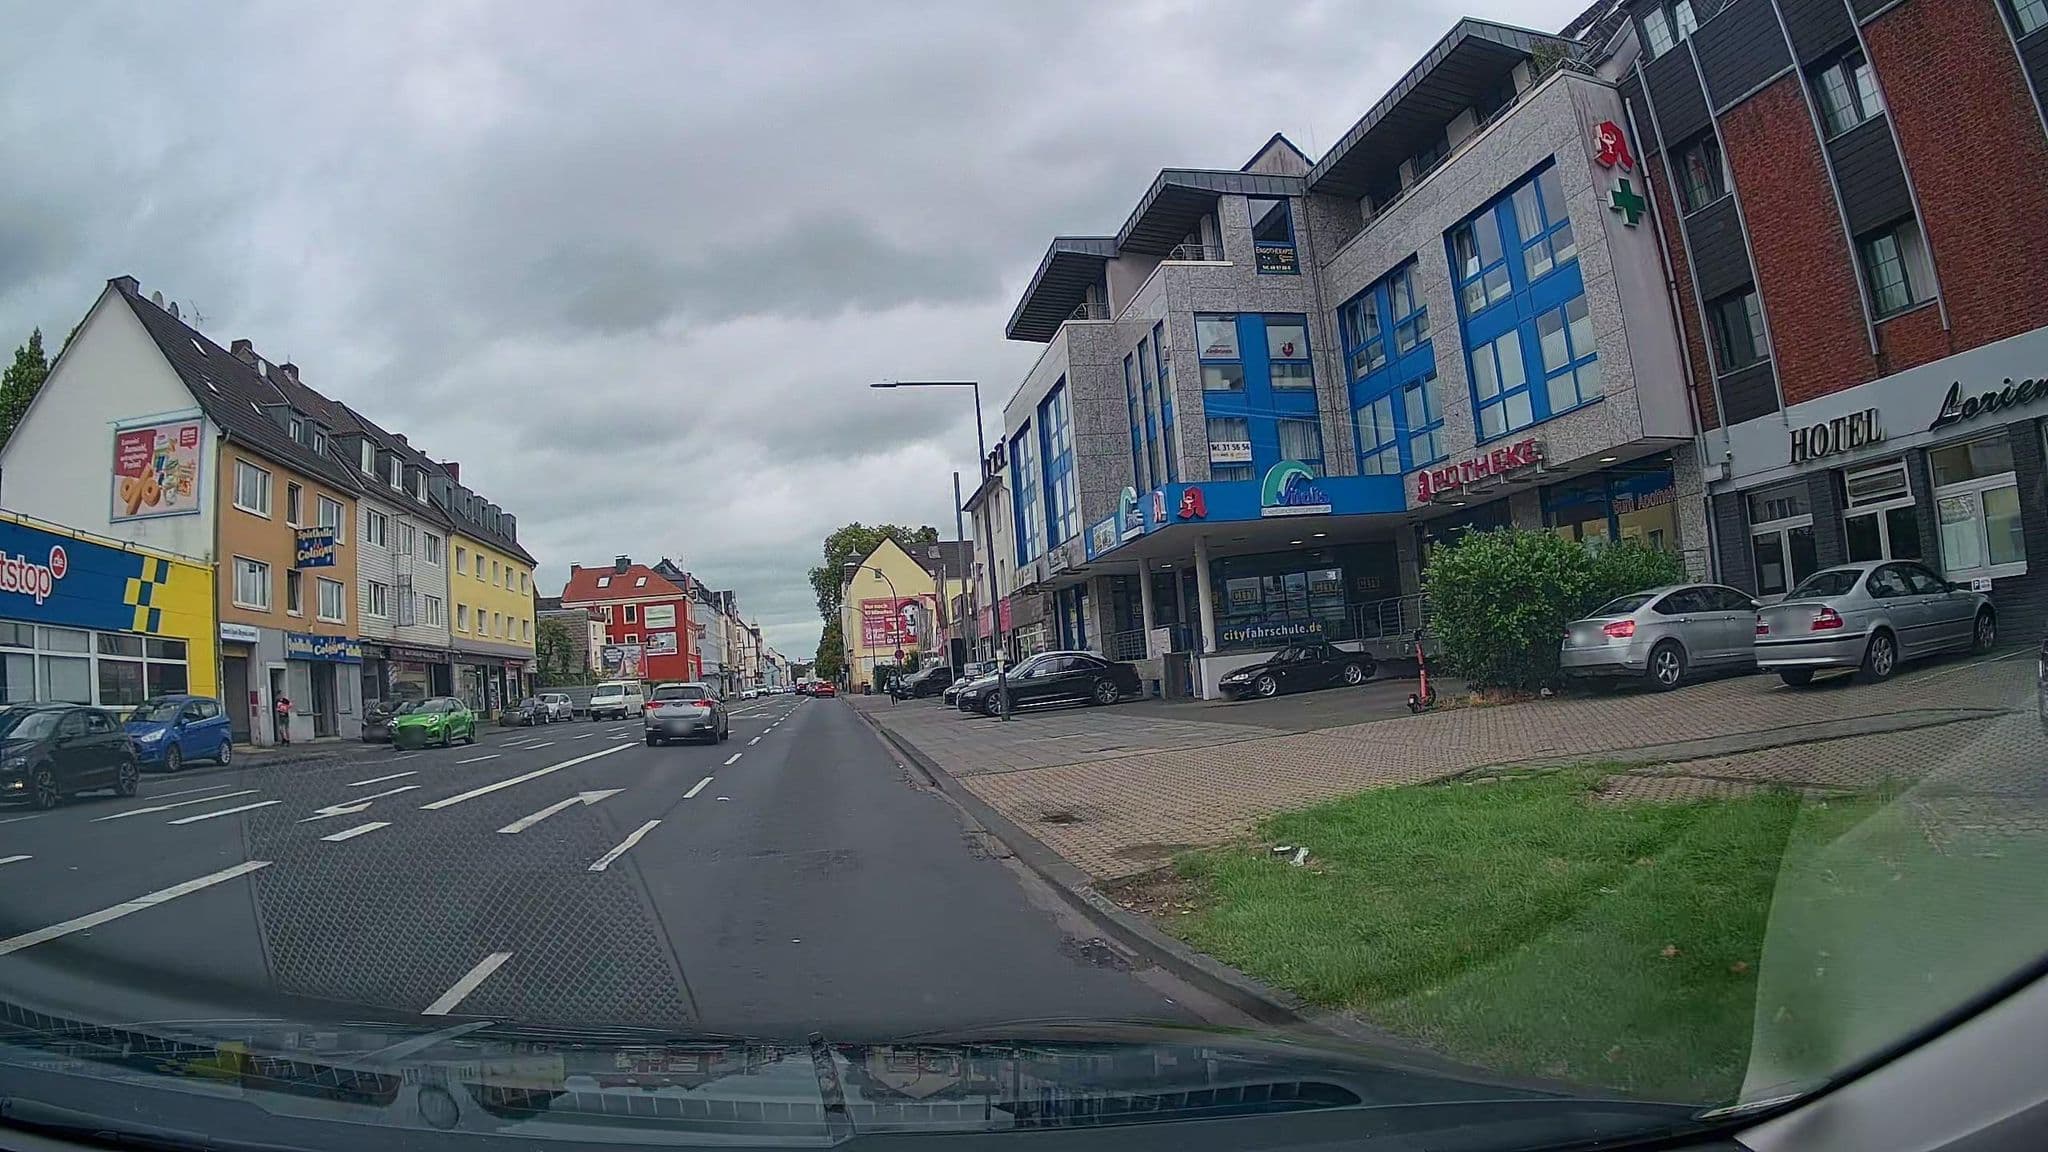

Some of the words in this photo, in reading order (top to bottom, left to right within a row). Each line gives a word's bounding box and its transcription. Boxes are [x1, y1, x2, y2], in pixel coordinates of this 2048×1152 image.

[1789, 407, 1885, 465] HOTEL
[1418, 438, 1539, 503] APOTHEKE
[1233, 588, 1257, 601] CITY
[1314, 580, 1338, 594] CITY
[1223, 622, 1322, 642] cityfahrschule.de
